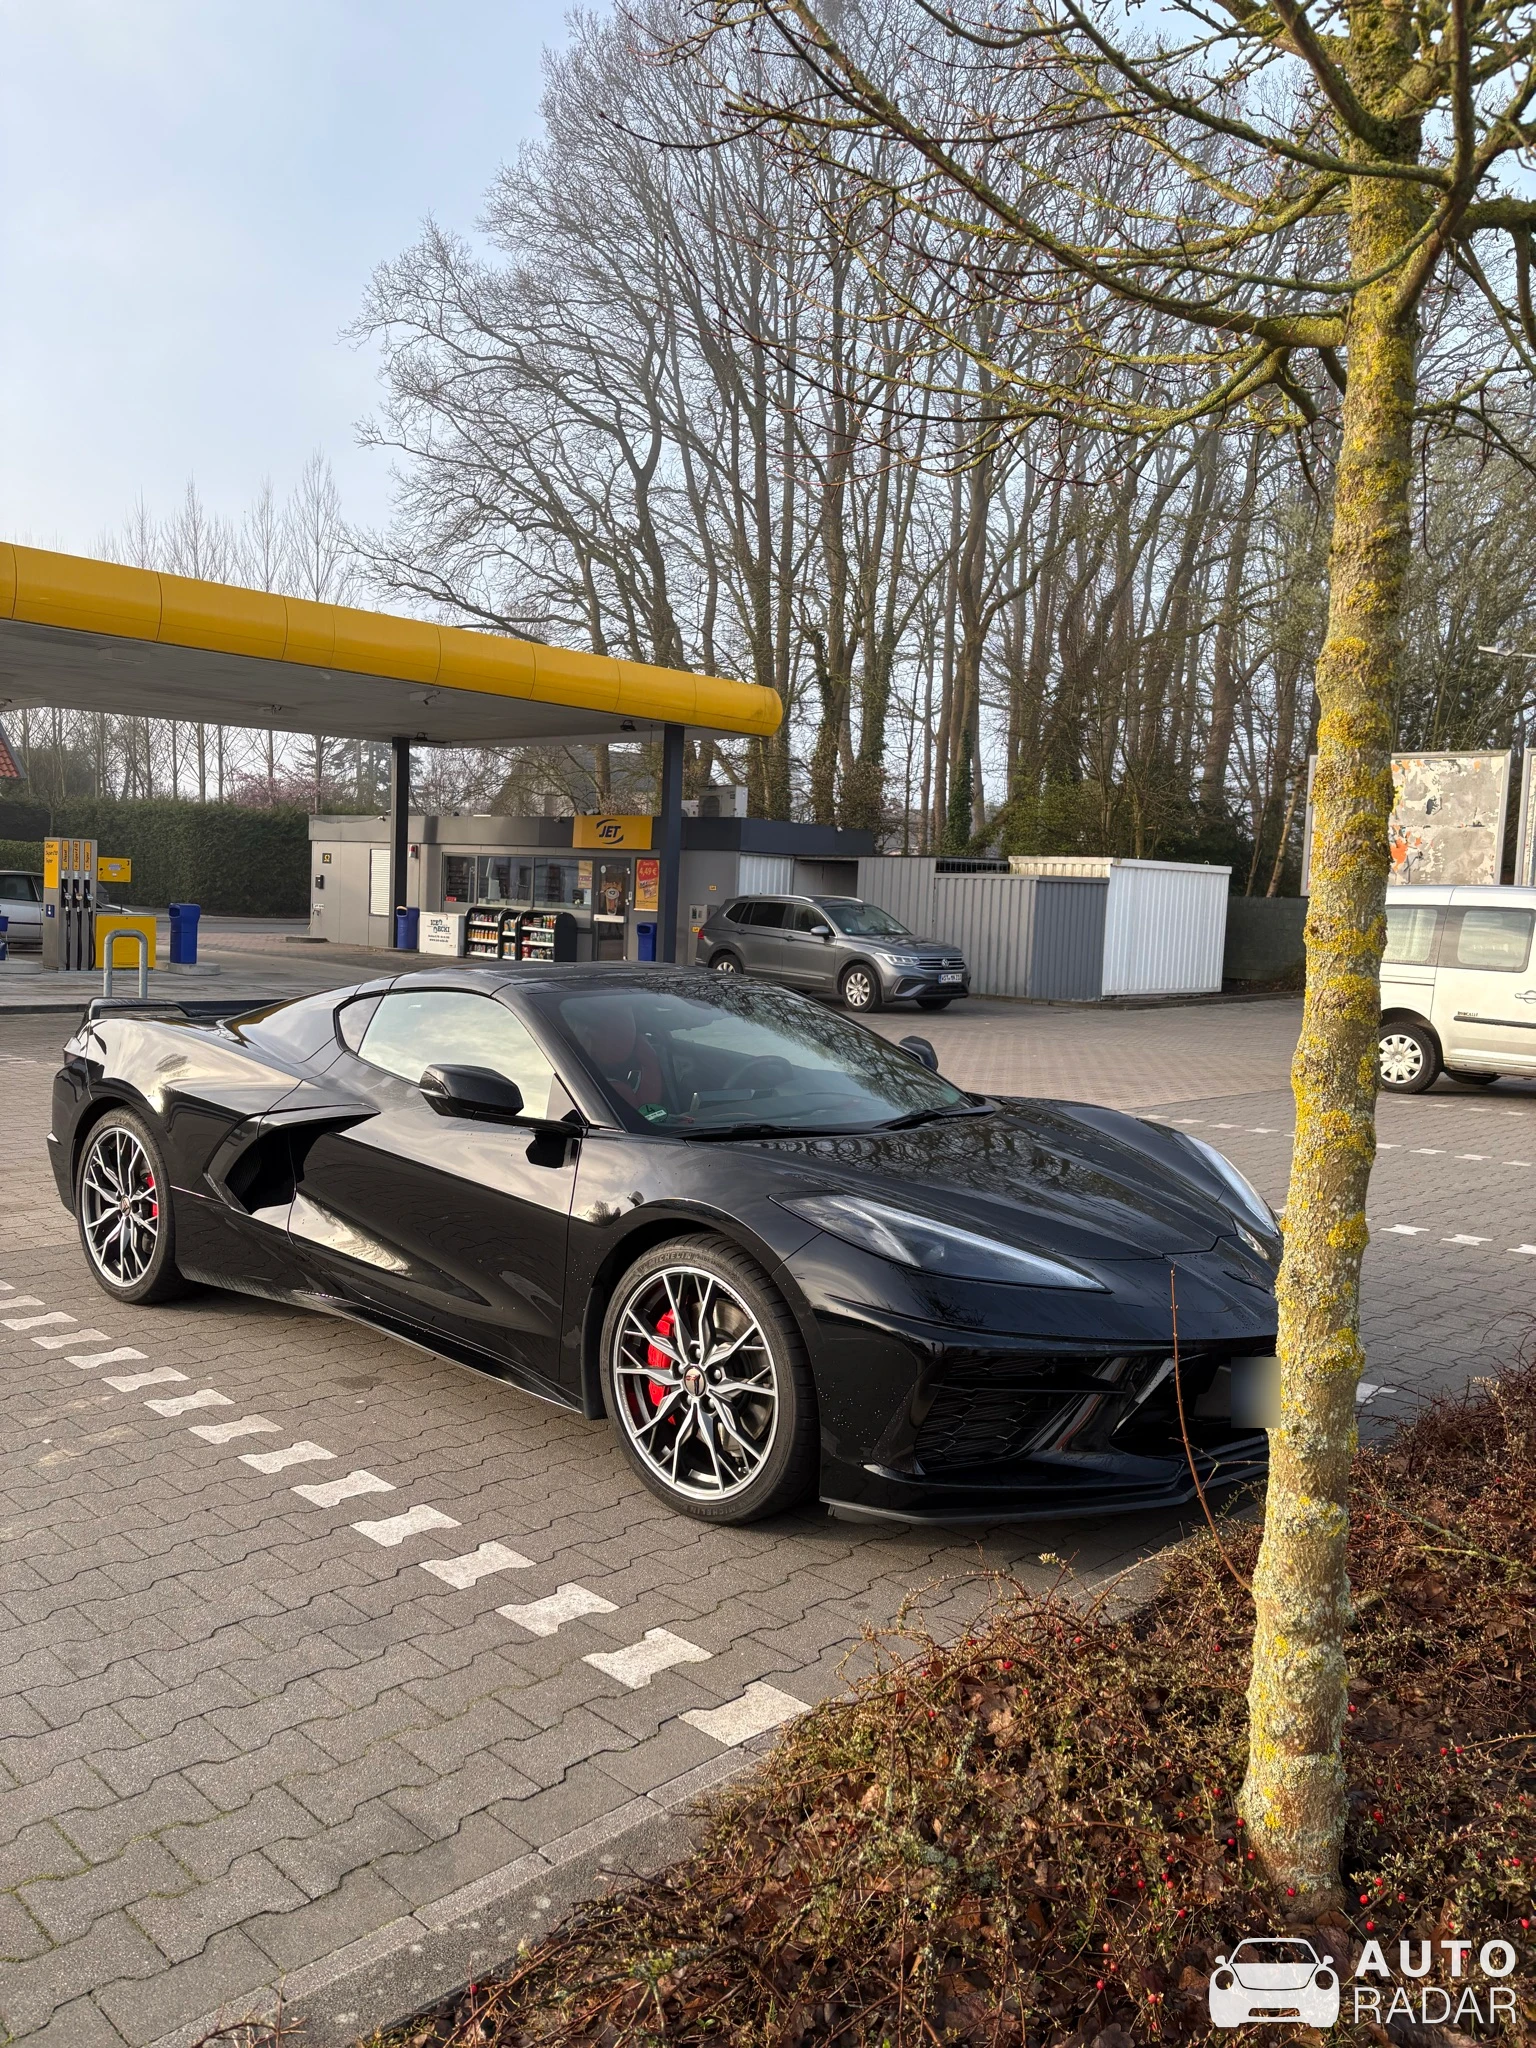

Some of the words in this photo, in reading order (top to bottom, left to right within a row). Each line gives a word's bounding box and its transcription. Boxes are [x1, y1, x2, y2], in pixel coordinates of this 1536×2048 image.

[599, 826, 621, 838] JET
[639, 867, 652, 877] 4,49
[648, 1251, 693, 1267] MICHELIN
